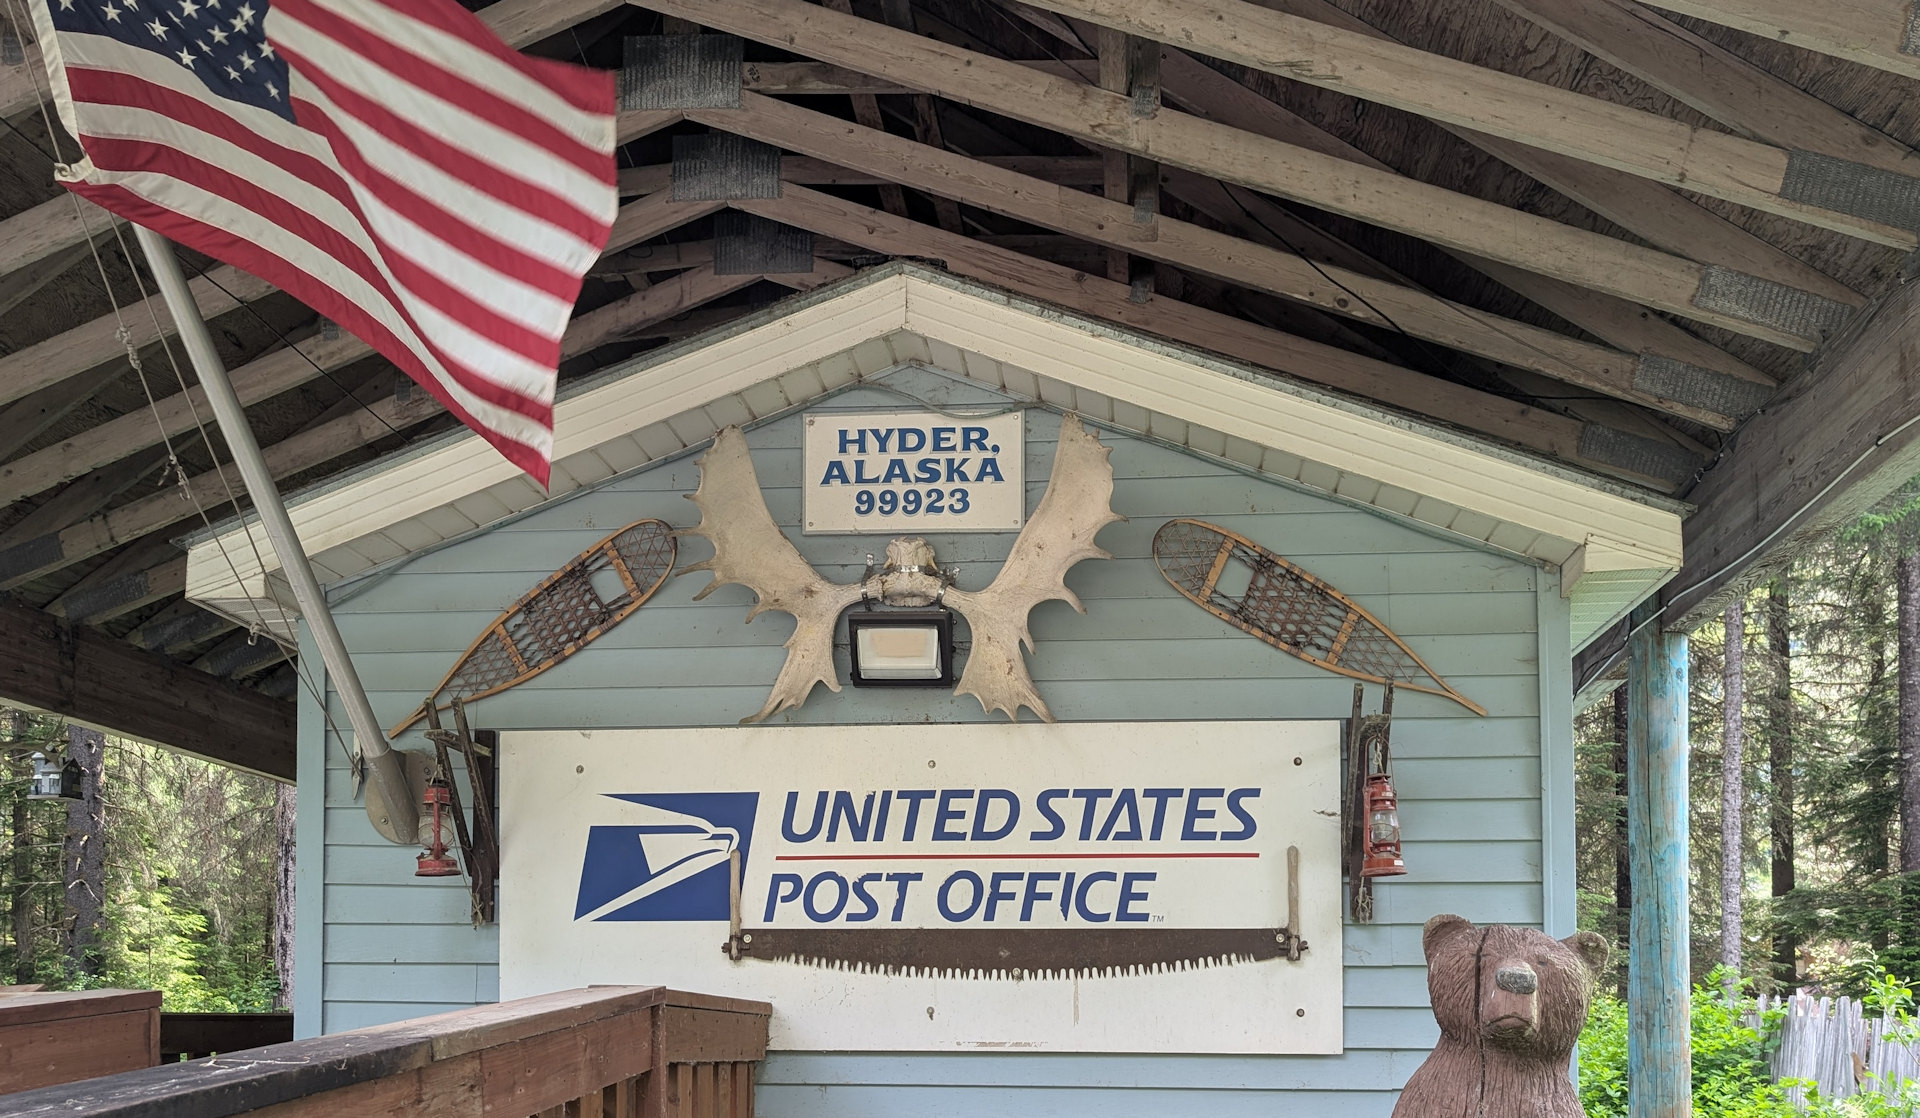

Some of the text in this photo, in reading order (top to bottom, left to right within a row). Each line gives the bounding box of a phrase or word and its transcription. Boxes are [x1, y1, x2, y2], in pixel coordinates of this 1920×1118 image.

[838, 427, 1001, 453] HYDER,
[821, 458, 1004, 485] ALASKA
[855, 488, 971, 515] 99923
[781, 788, 1262, 843] UNITED STATES
[763, 870, 1157, 923] POST OFFICE
[1152, 914, 1165, 923] TM
